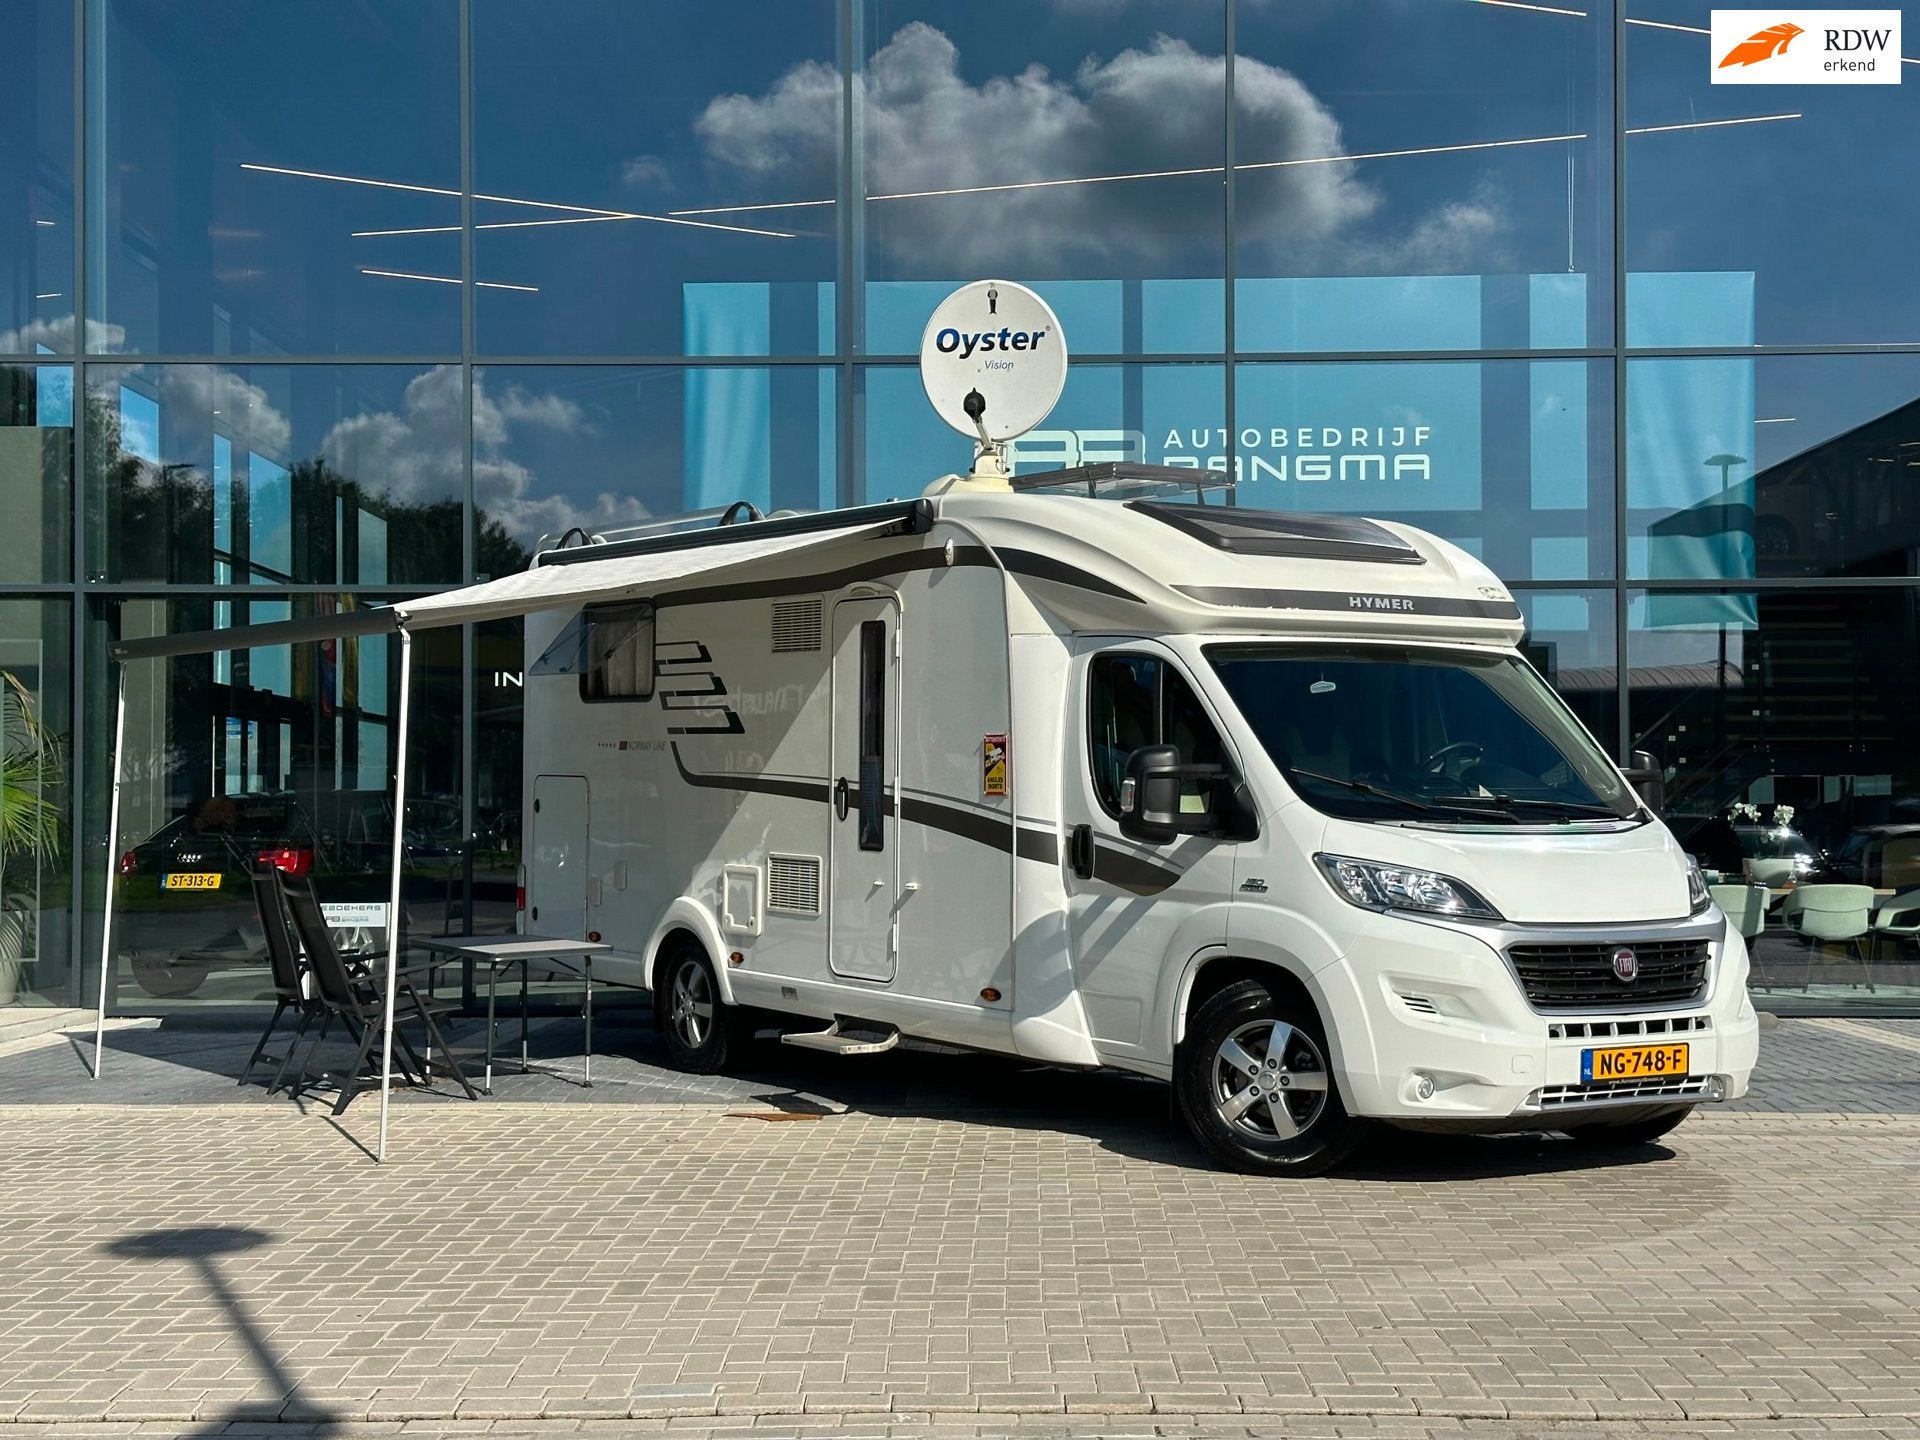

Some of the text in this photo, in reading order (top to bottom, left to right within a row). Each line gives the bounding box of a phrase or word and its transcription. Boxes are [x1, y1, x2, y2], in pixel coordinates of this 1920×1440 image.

[936, 327, 1045, 359] Oyster
[984, 360, 1014, 370] Vision
[1163, 426, 1430, 448] AUTOBEDRIJF
[1349, 596, 1415, 611] HYMER
[171, 875, 215, 887] ST-313-G
[1619, 957, 1633, 972] FIAT
[1600, 1049, 1682, 1075] NG-748-F
